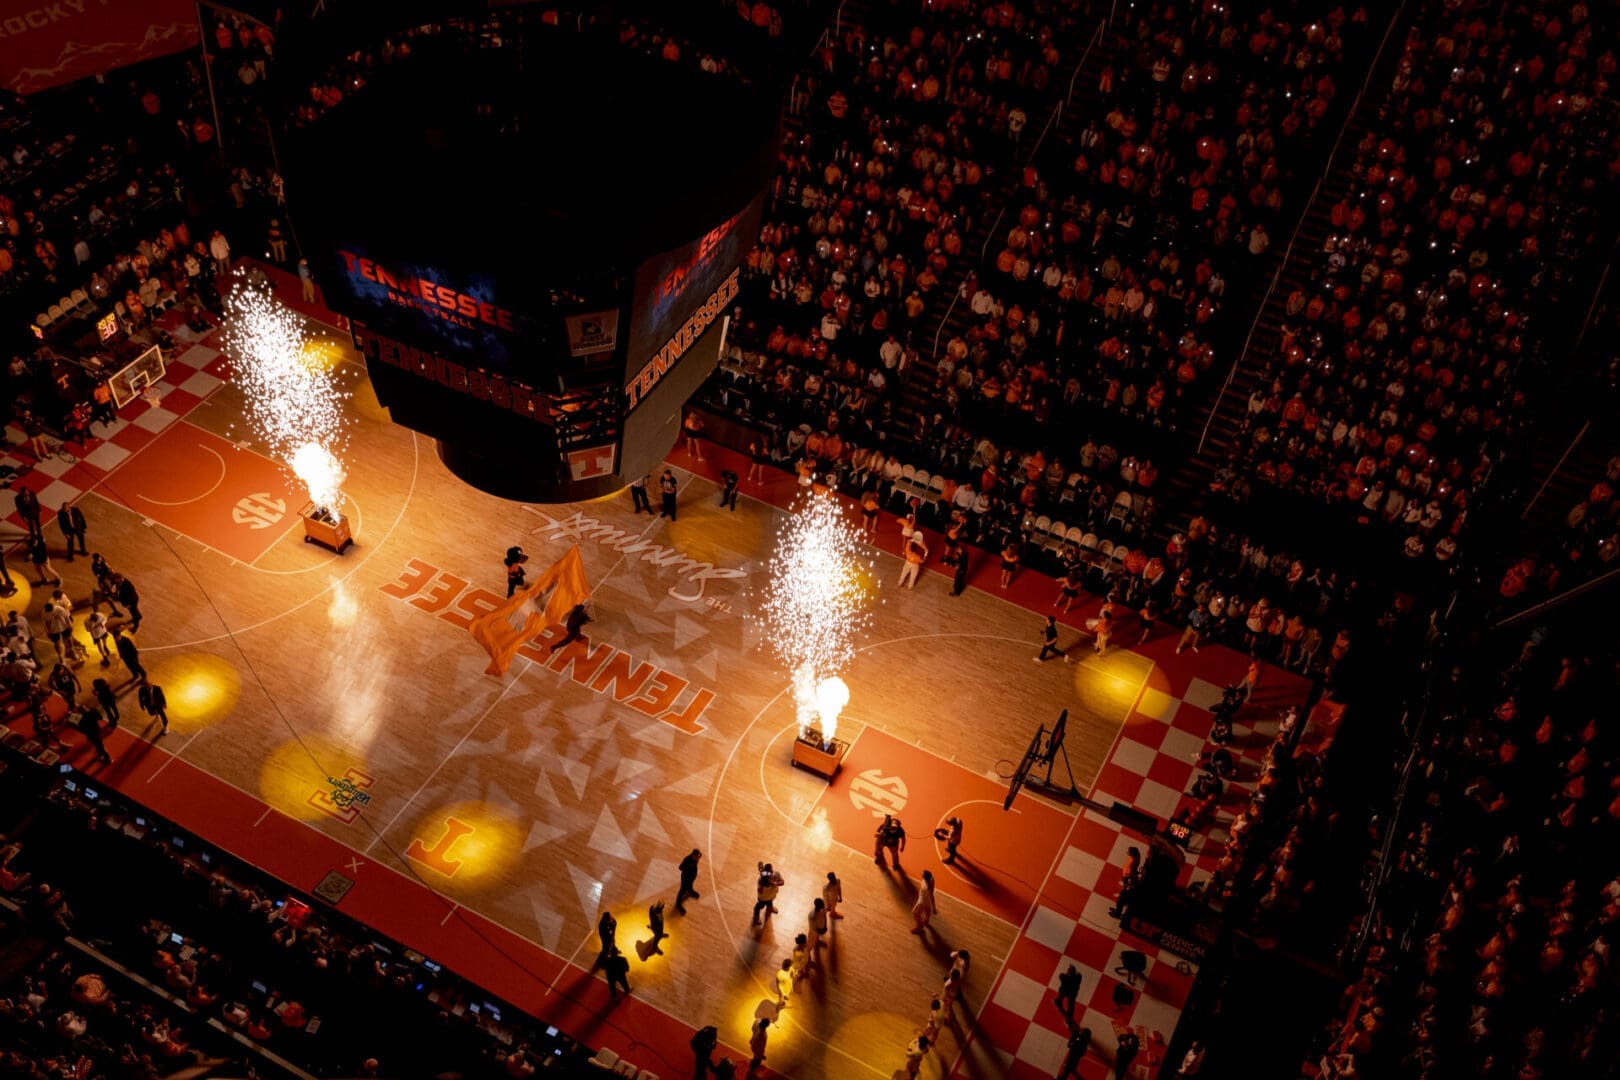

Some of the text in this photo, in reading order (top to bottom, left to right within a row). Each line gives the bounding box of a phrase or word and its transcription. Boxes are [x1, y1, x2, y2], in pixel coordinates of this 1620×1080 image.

[625, 266, 740, 410] TENNESSEE
[232, 493, 286, 530] SEC
[704, 595, 733, 615] THE
[379, 557, 717, 735] TENNESEE
[849, 769, 909, 818] SEC
[402, 815, 476, 879] T
